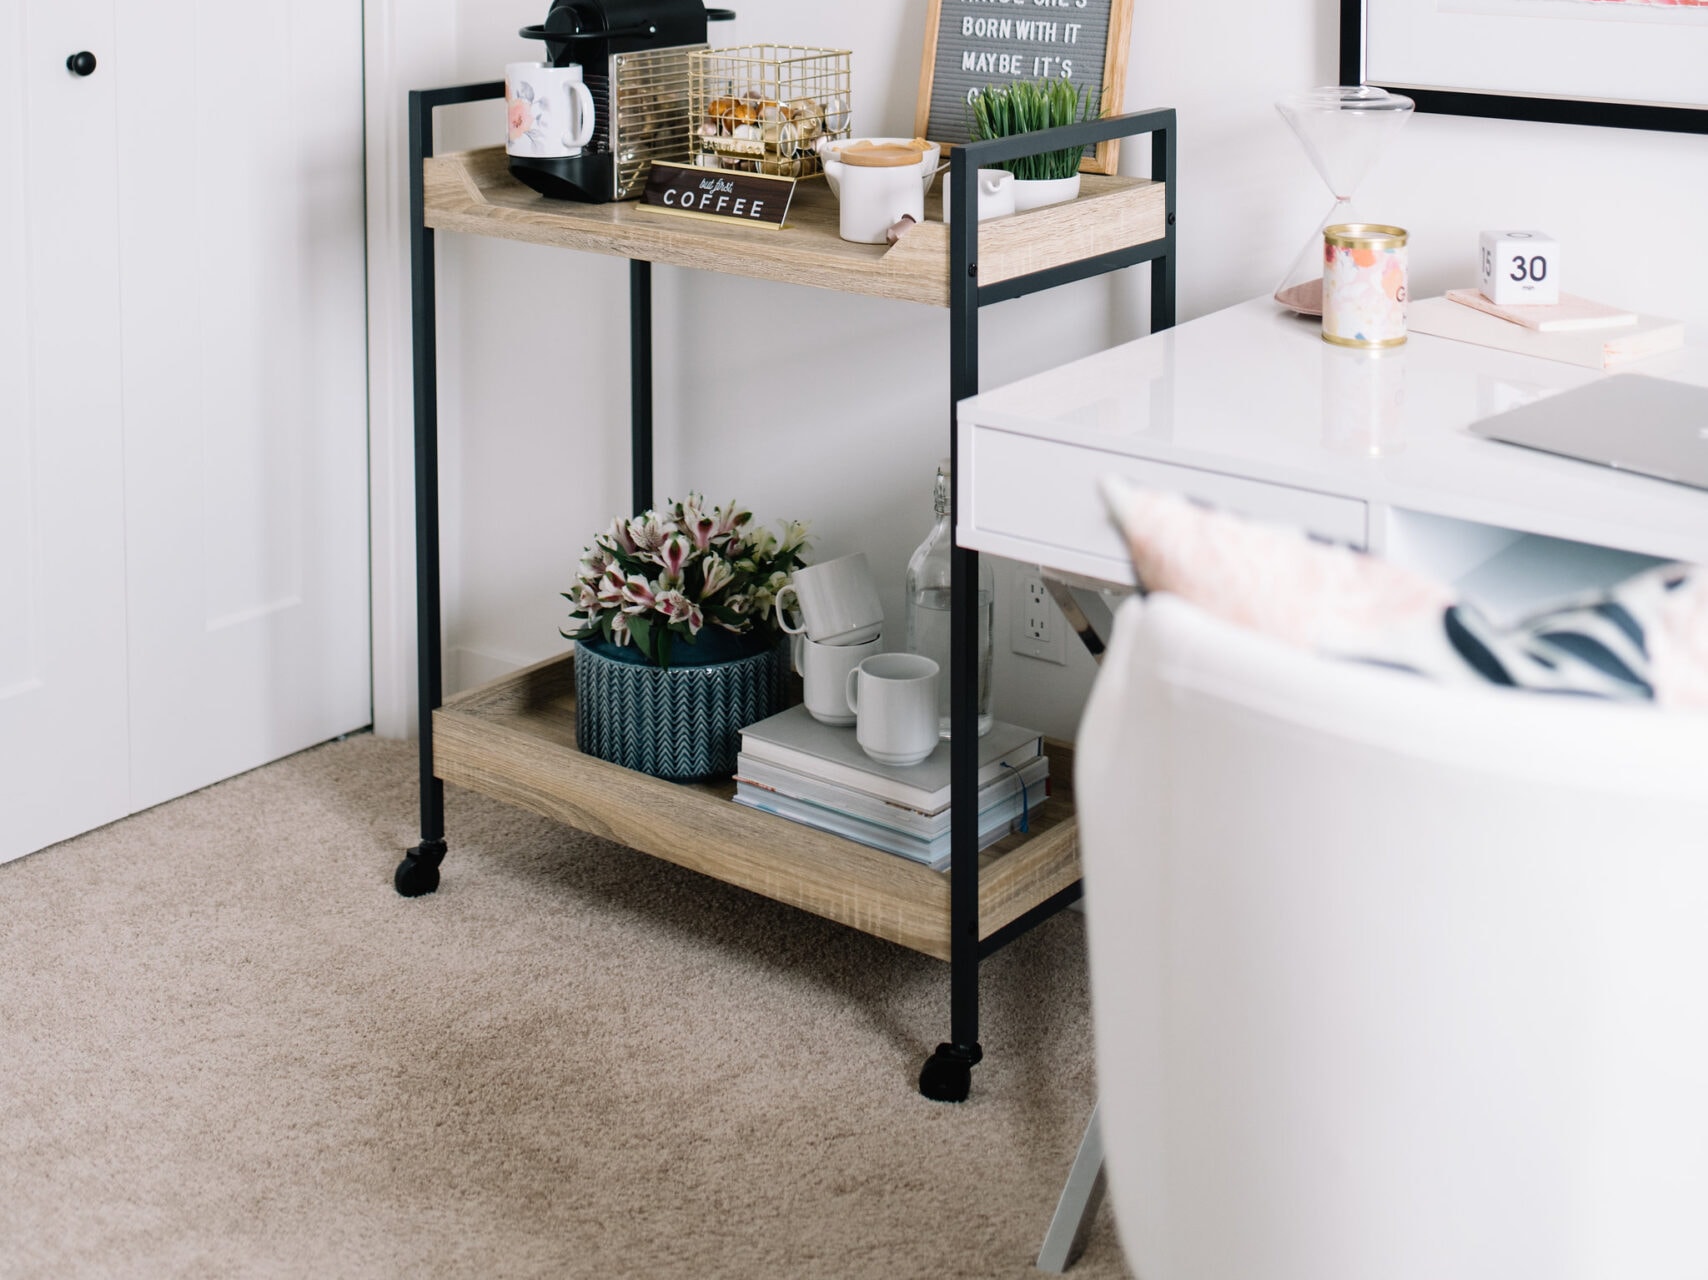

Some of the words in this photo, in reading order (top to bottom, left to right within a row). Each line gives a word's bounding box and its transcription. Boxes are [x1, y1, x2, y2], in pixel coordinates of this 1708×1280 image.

[962, 16, 1011, 39] BORN
[1016, 19, 1057, 43] WITH
[1063, 23, 1082, 45] IT
[962, 51, 1023, 75] MAYBE
[1033, 56, 1073, 79] IT'S
[663, 189, 764, 217] COFFEE
[1510, 255, 1547, 282] 30
